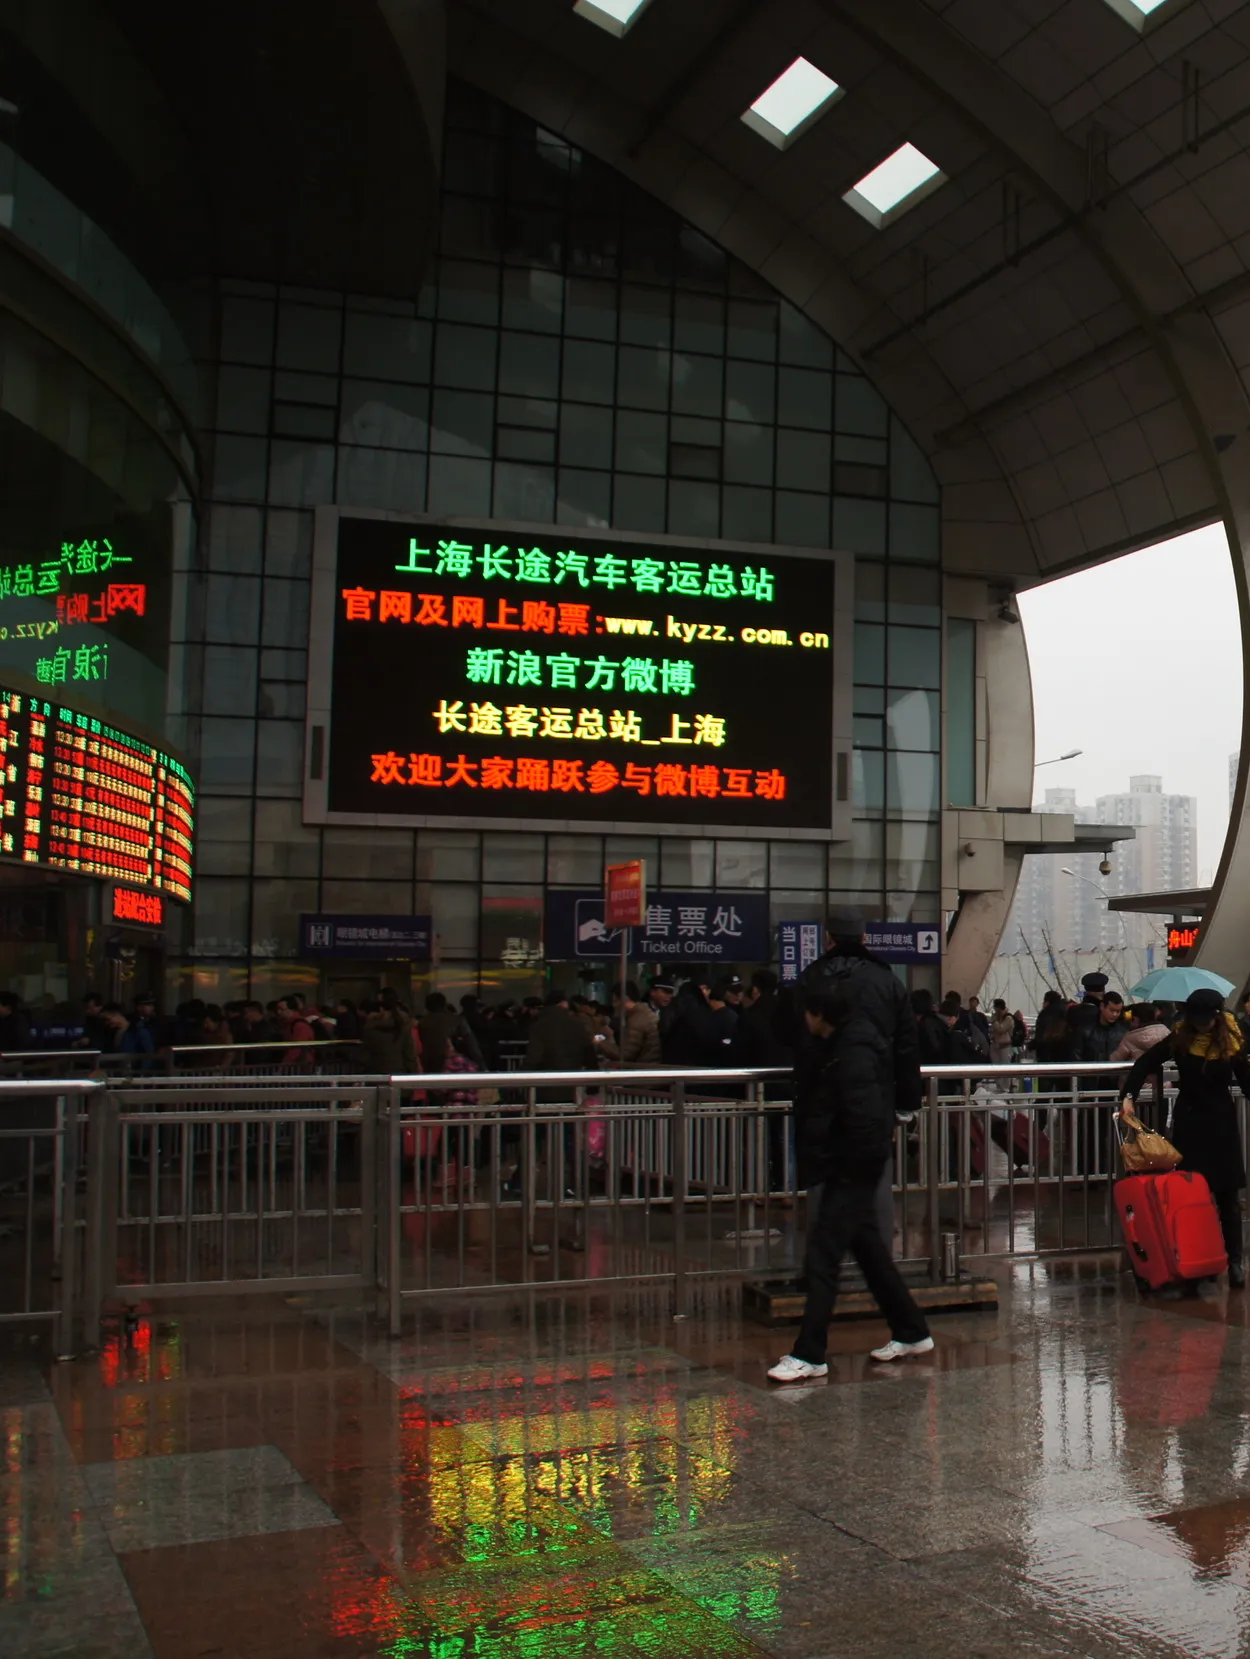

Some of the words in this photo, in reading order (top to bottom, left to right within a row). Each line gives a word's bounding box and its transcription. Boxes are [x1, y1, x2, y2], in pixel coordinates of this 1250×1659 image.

[395, 538, 775, 602] 上海长途汽车客运总站
[465, 646, 696, 696] 新浪官方微博
[432, 699, 726, 747] 长途客运总站_上海
[369, 750, 787, 801] 欢迎大家踊跃参与微博互动
[644, 904, 744, 937] 售票处
[640, 940, 681, 954] Ticket
[685, 940, 723, 954] Office
[782, 925, 798, 981] 当日票
